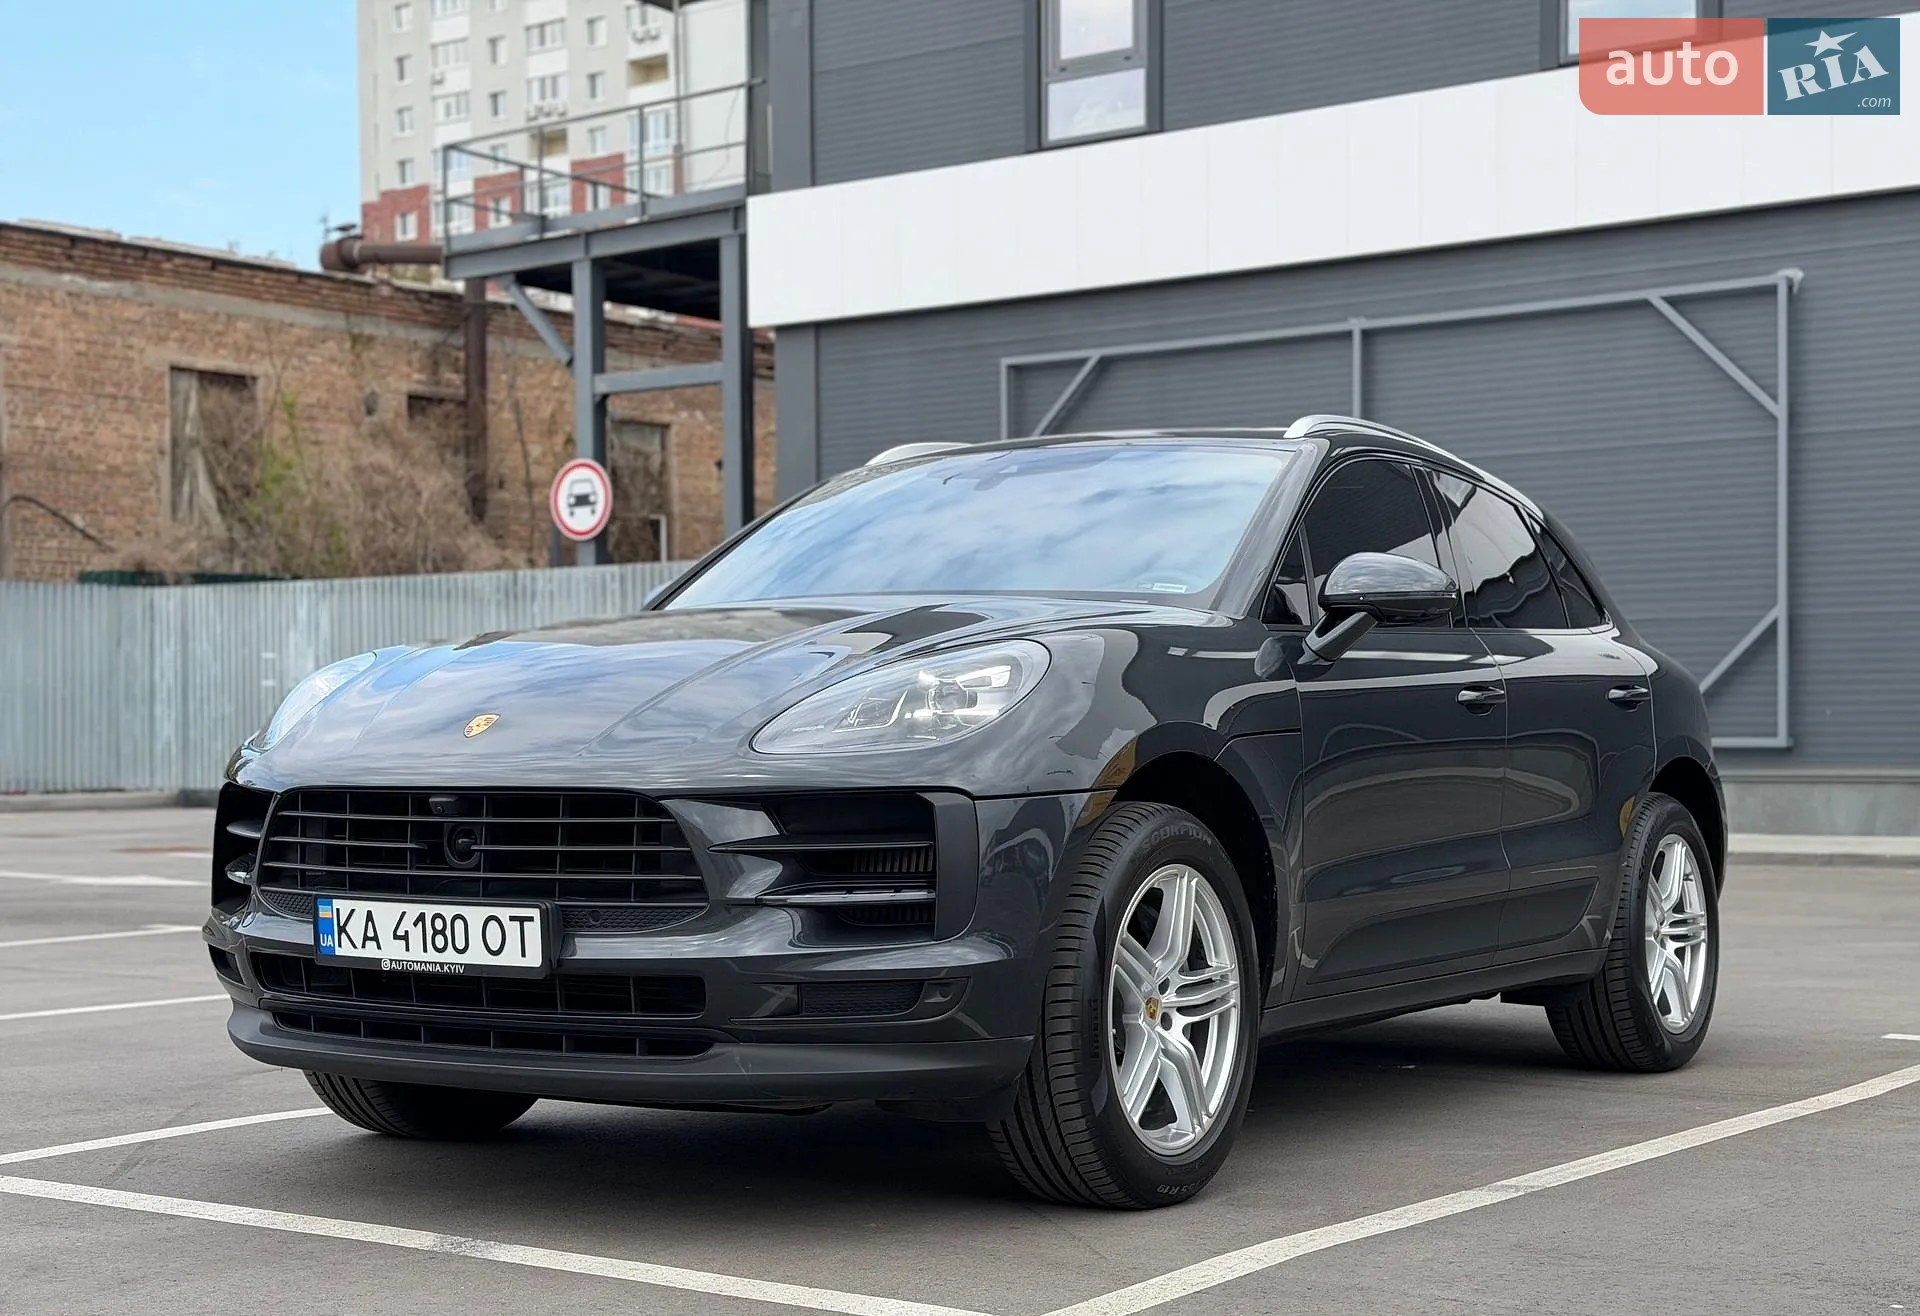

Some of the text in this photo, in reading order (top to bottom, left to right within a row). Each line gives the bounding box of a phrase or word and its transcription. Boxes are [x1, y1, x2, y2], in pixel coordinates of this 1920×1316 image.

[320, 933, 334, 947] UA
[336, 908, 535, 958] KA 4180 OT
[391, 959, 465, 974] AUTOMANIA.KYIV
